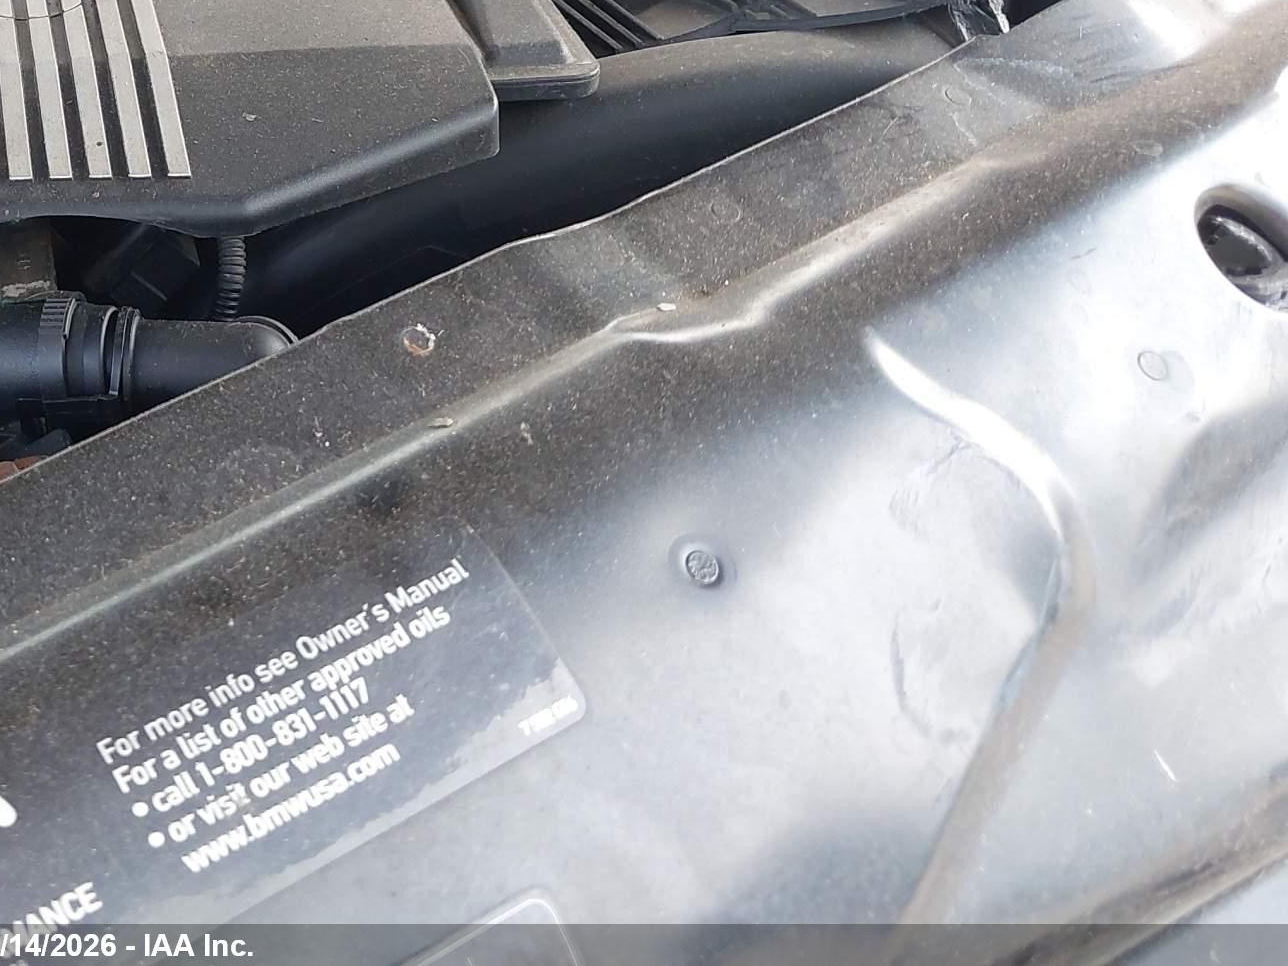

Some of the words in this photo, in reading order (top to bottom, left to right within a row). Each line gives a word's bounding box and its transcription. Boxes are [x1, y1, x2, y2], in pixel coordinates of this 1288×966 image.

[96, 731, 141, 765] For
[144, 698, 209, 741] more
[205, 674, 255, 709] info
[255, 651, 299, 683] see
[385, 559, 470, 613] Manual
[112, 758, 159, 794] For
[160, 748, 182, 770] a
[176, 724, 221, 759] list
[219, 706, 248, 739] of
[246, 680, 305, 725] other
[307, 624, 411, 692] approved
[408, 605, 451, 639] oils
[151, 772, 200, 812] call
[195, 677, 370, 786] 1-800-831-1117
[168, 813, 197, 842] or
[196, 782, 250, 825] visit
[249, 763, 291, 799] our
[290, 733, 345, 773] web
[343, 710, 388, 746] site
[386, 694, 415, 725] at
[181, 743, 401, 873] www.bmwusa.com
